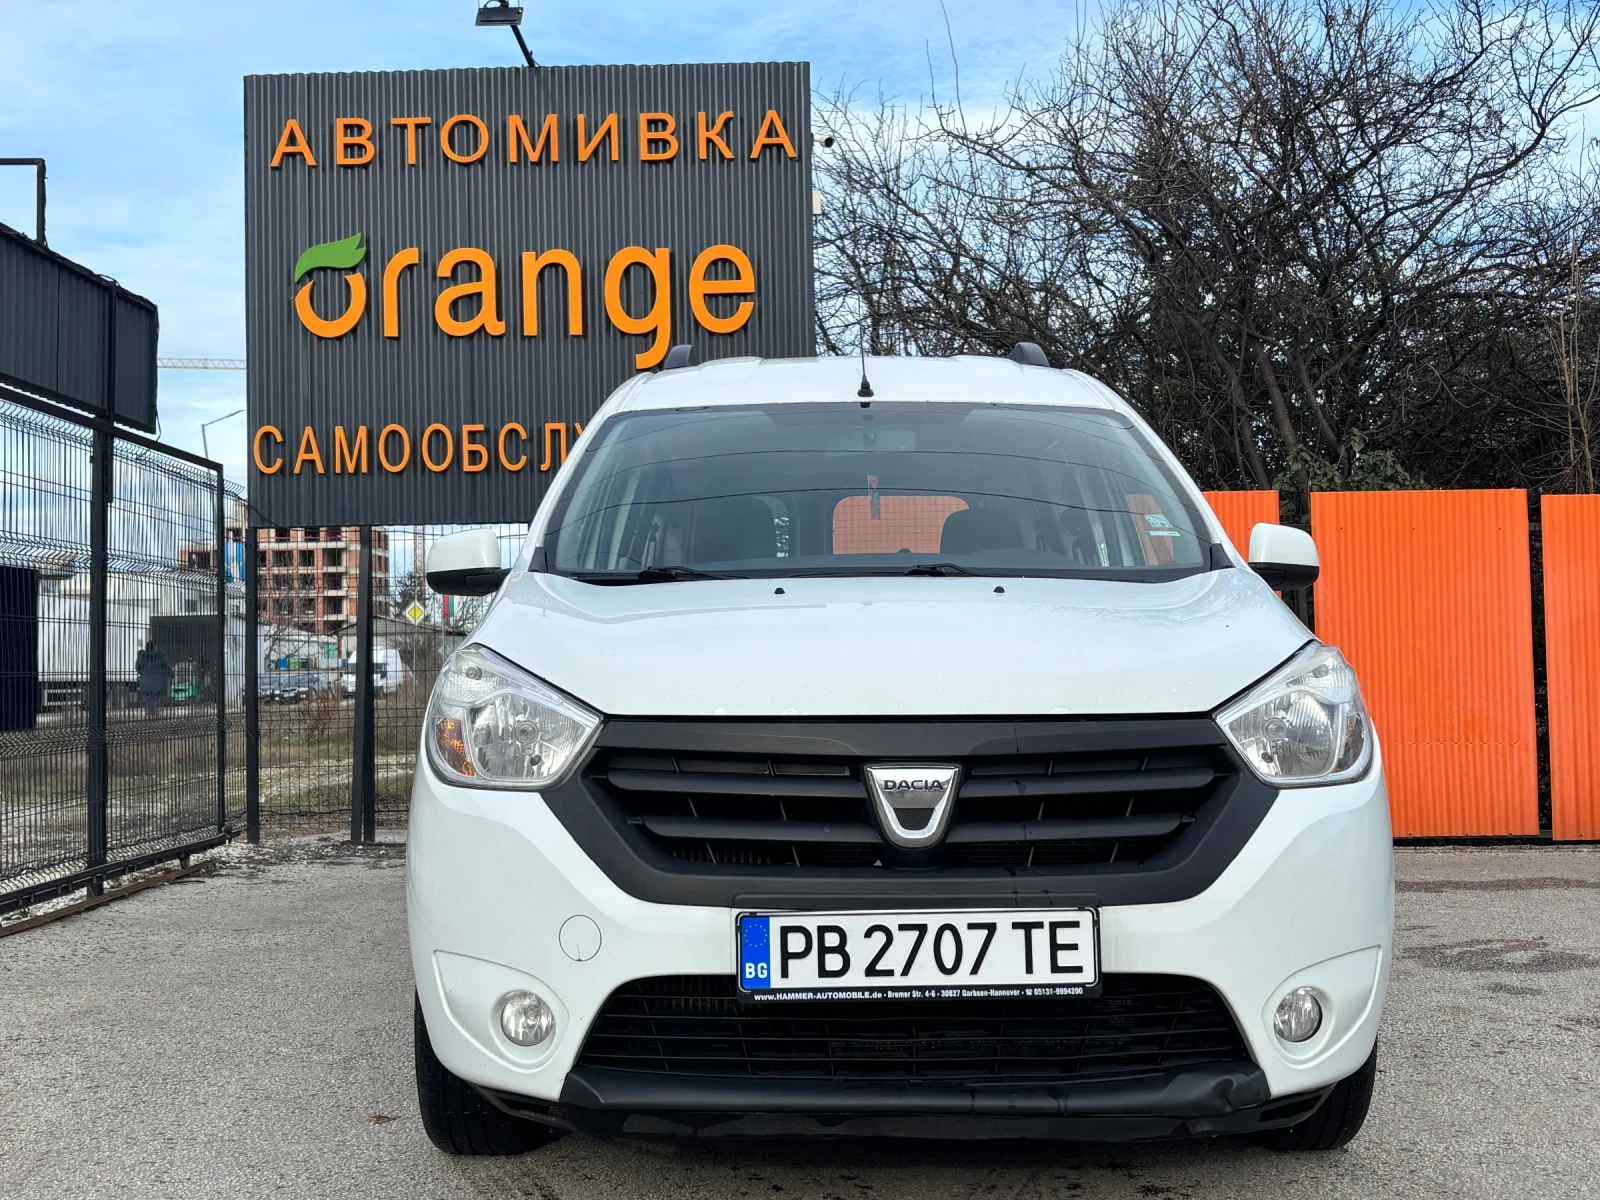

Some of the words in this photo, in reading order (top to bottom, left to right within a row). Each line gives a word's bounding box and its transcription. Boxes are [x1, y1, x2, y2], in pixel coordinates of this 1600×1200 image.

[271, 110, 797, 167] АВТОМИВКА
[295, 243, 756, 370] orange
[253, 423, 584, 474] САМООБСЛ
[883, 779, 944, 792] DACIA
[745, 963, 768, 979] BG
[780, 925, 851, 979] PB
[864, 922, 997, 978] 2707
[1011, 920, 1084, 976] TE
[754, 990, 882, 1001] www.HAMMER-AUTOMOBILE.de
